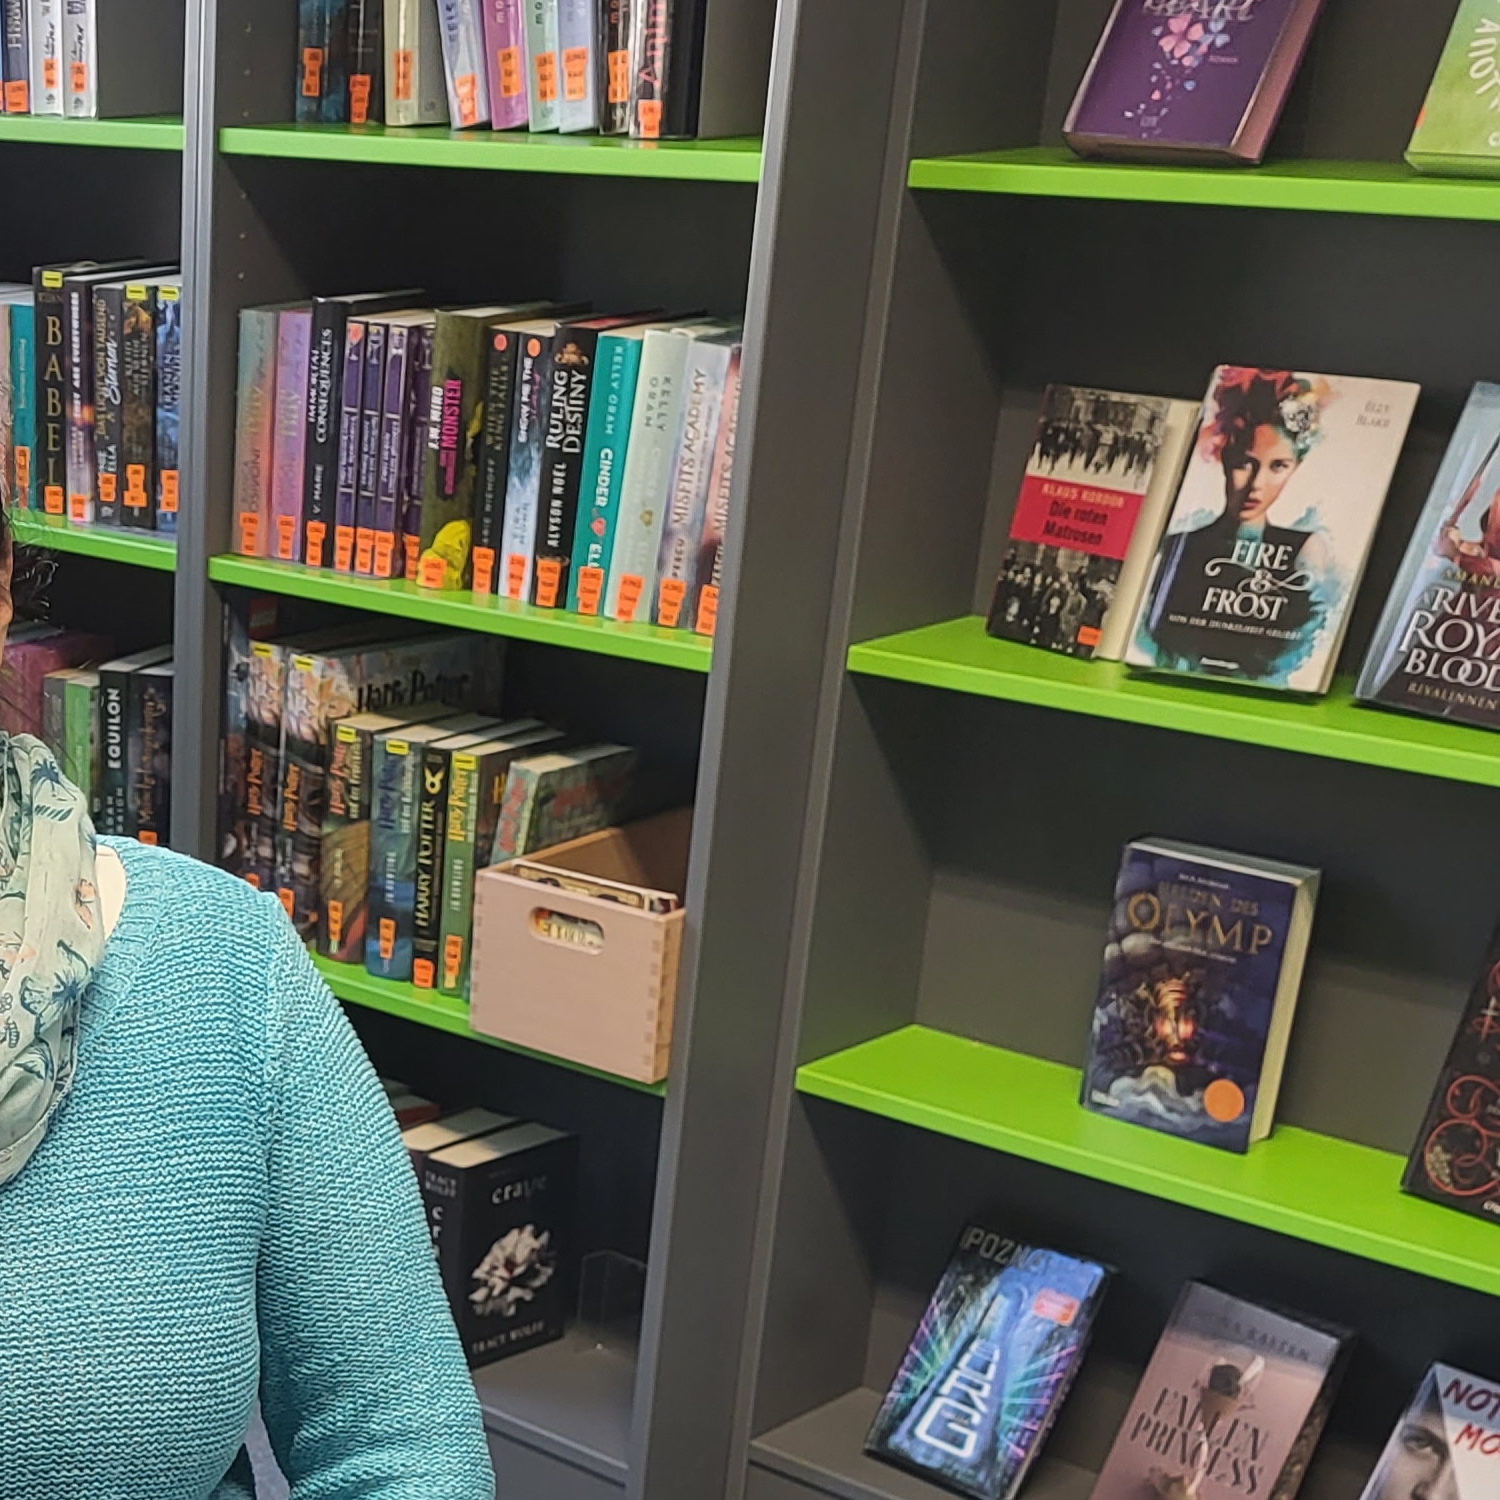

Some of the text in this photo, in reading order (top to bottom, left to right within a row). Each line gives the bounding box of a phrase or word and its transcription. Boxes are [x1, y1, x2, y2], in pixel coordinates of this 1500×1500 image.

[546, 370, 569, 449] RULING
[562, 369, 588, 453] DESTINY
[595, 448, 614, 507] CINDER
[672, 457, 696, 526] MISFITS
[684, 368, 707, 453] ACADEMY
[547, 502, 564, 548] ALYSON
[1231, 540, 1293, 571] FIRE
[1202, 588, 1288, 622] FROST
[1398, 610, 1500, 662] ROY
[107, 688, 121, 769] EQUILON
[415, 800, 435, 927] HARRY POTTER
[1127, 892, 1273, 955] OLYMP
[1130, 1412, 1264, 1495] PRINCESS
